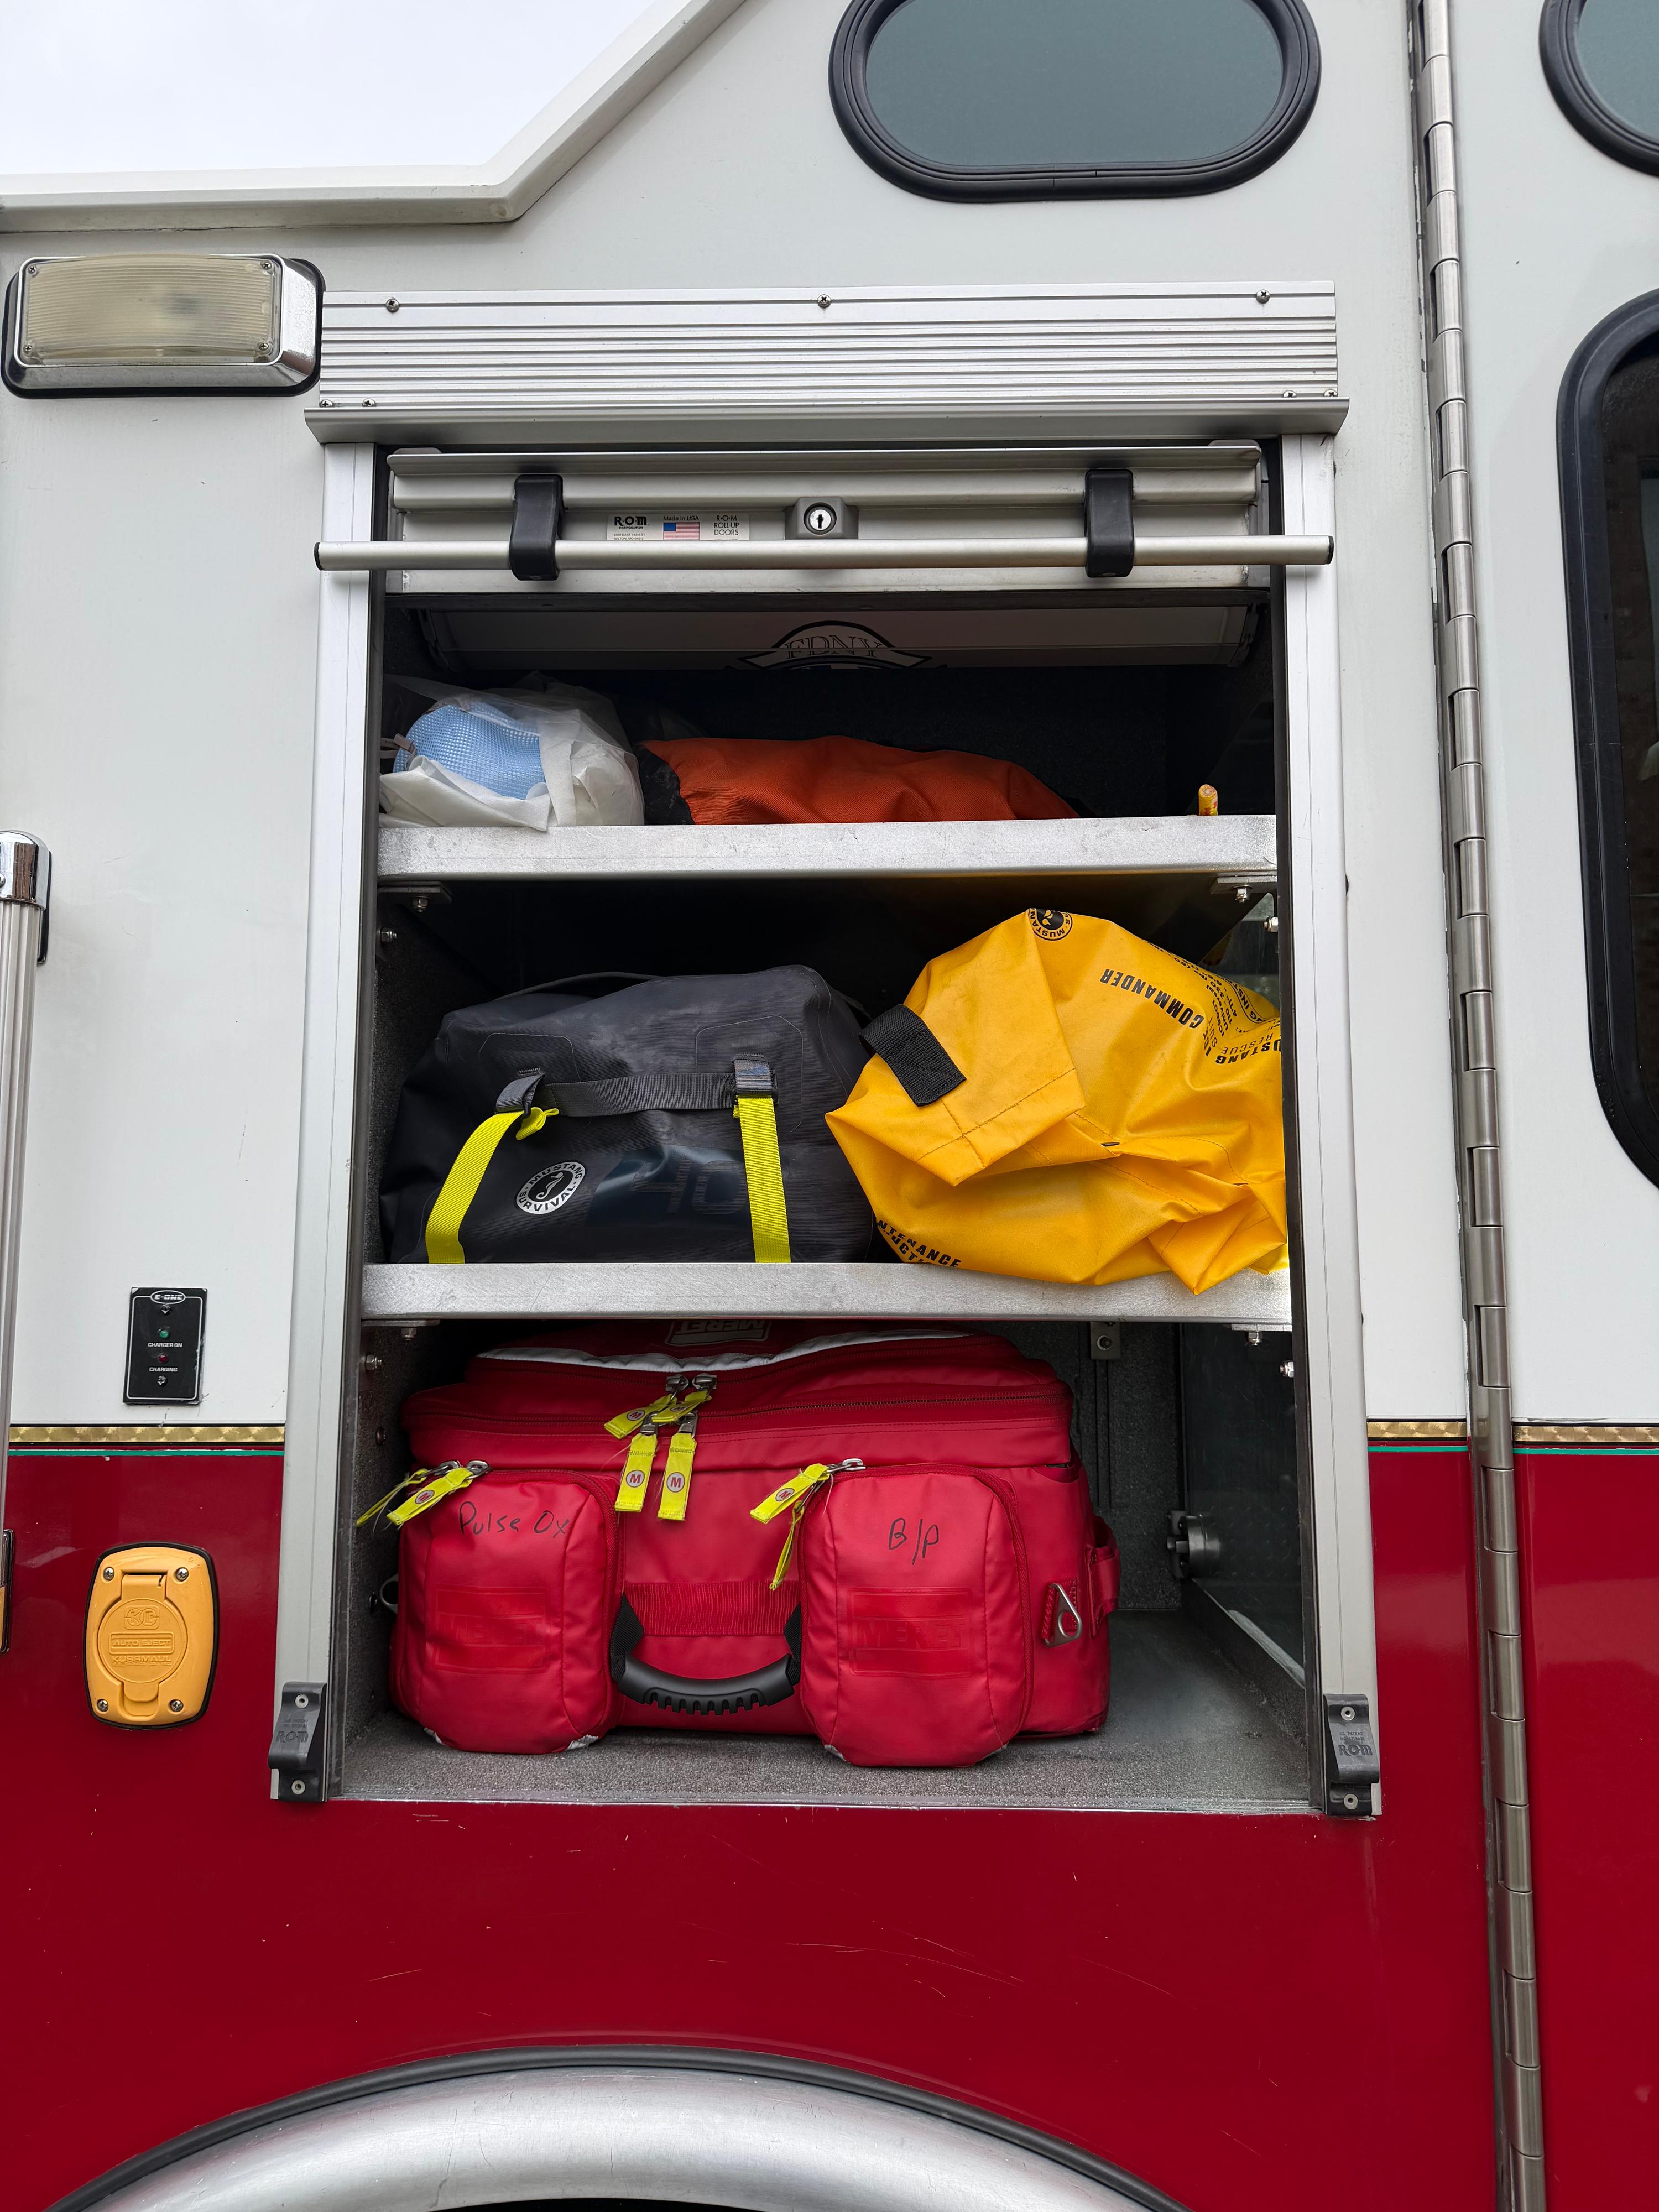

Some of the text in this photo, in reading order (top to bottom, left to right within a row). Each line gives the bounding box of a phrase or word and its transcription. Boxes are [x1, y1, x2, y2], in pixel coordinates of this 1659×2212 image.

[784, 635, 883, 659] FDNY
[1030, 908, 1065, 938] MUSTAN
[1099, 968, 1205, 1030] COMMANDER
[1215, 1038, 1282, 1065] USTANG
[1221, 1032, 1274, 1055] RESCUE
[528, 1163, 582, 1186] MUSTANG
[519, 1185, 577, 1212] SURVIVAL
[876, 1219, 962, 1268] NTENANCE
[629, 1473, 641, 1484] M
[670, 1477, 682, 1488] M
[458, 1501, 570, 1539] Pulse Ox
[888, 1517, 940, 1566] B/P
